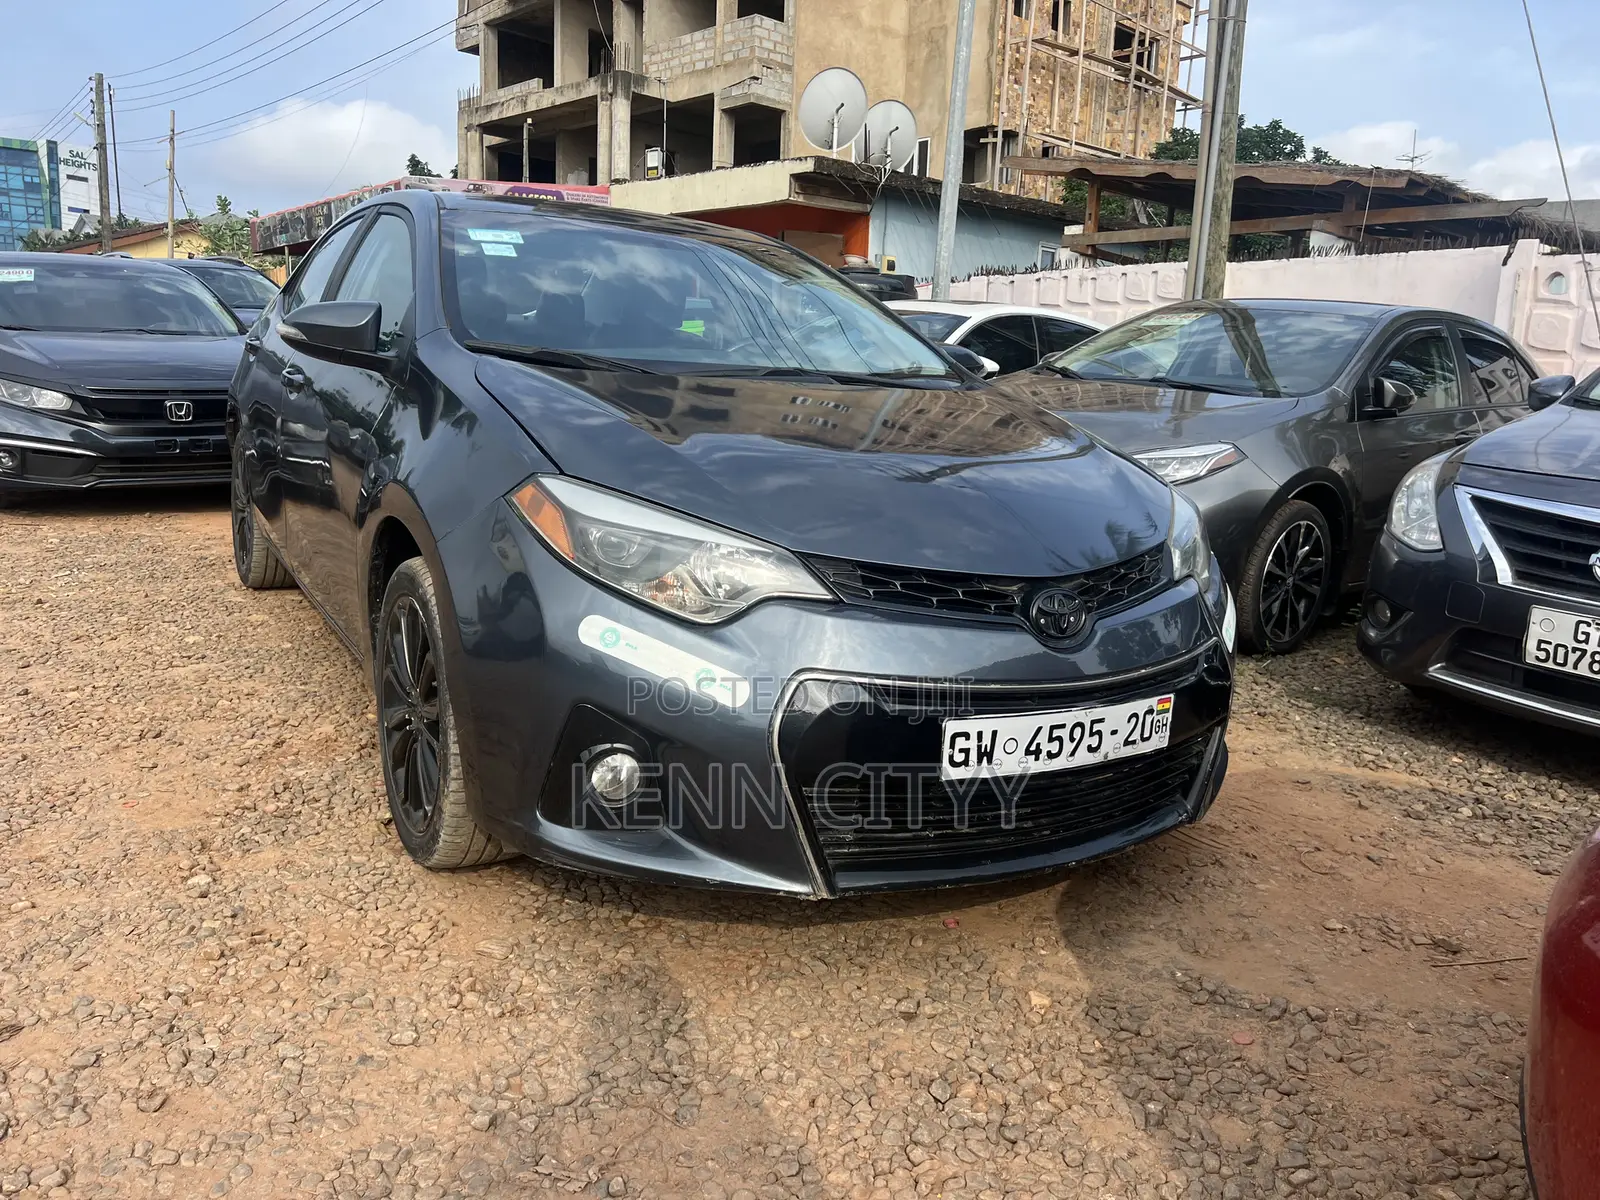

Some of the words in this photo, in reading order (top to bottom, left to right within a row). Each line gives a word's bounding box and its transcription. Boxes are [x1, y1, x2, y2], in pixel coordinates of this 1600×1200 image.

[59, 157, 98, 171] HEIGHTS
[69, 150, 87, 161] SAL
[1534, 638, 1600, 675] 5078
[1154, 716, 1169, 735] GH
[949, 729, 998, 769] GW
[1024, 707, 1155, 763] 4595-20
